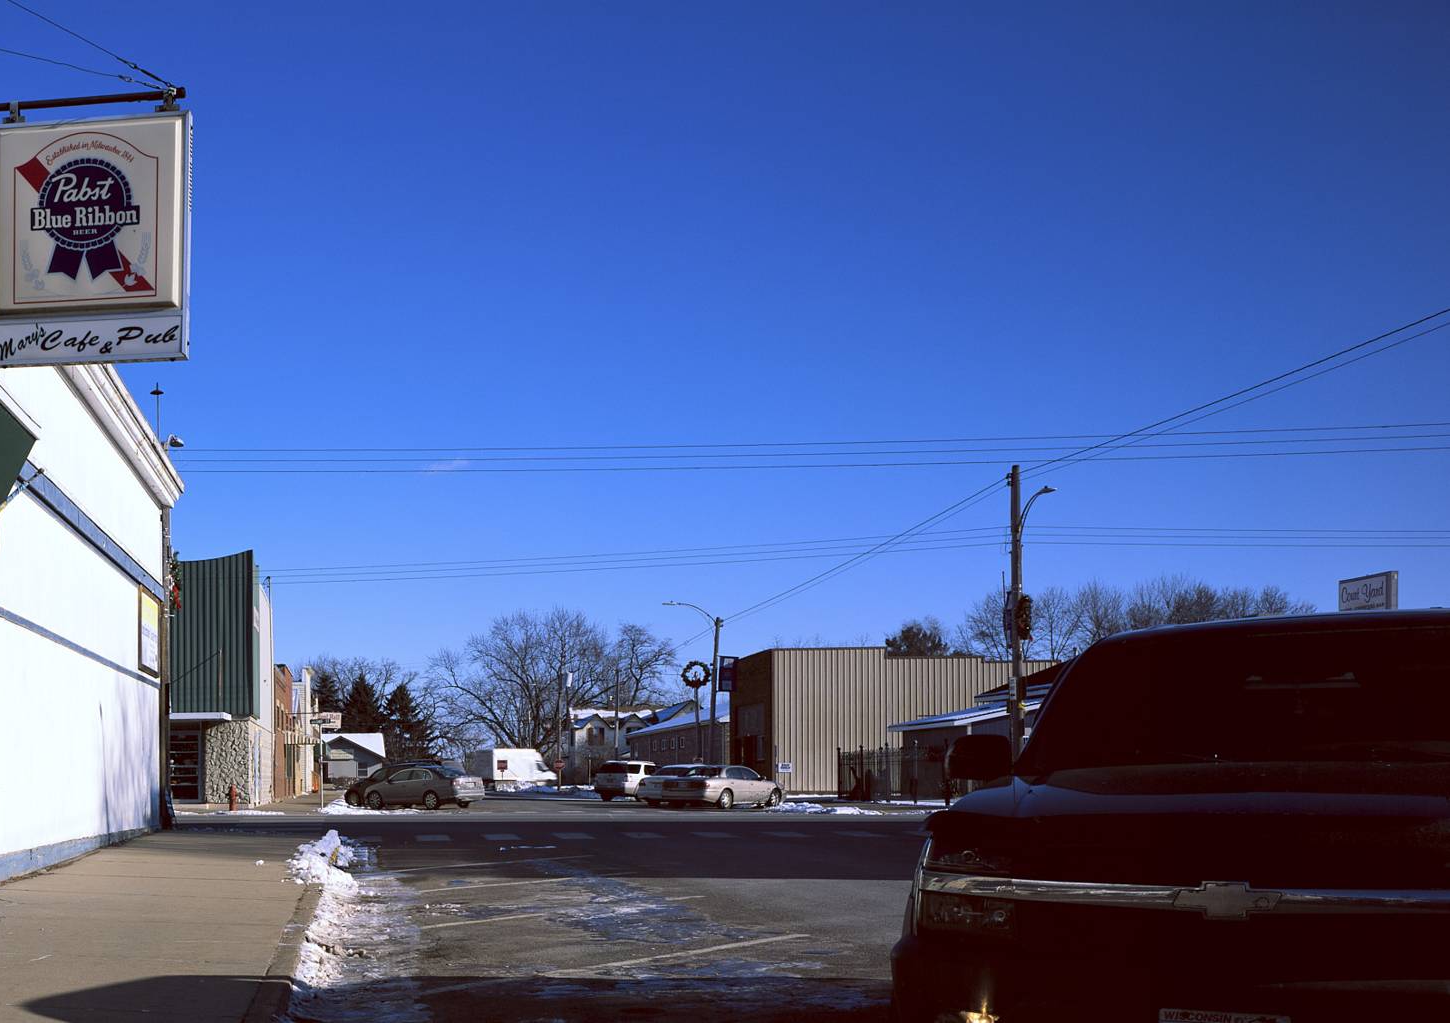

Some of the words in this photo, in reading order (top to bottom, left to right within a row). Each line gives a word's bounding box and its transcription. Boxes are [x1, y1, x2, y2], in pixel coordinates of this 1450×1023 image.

[51, 172, 114, 203] Pabst
[32, 208, 72, 230] Blue
[74, 205, 138, 227] Ribbon
[73, 228, 98, 236] BEER
[41, 329, 100, 356] Cafe
[99, 340, 113, 354] &
[116, 325, 179, 346] Pub
